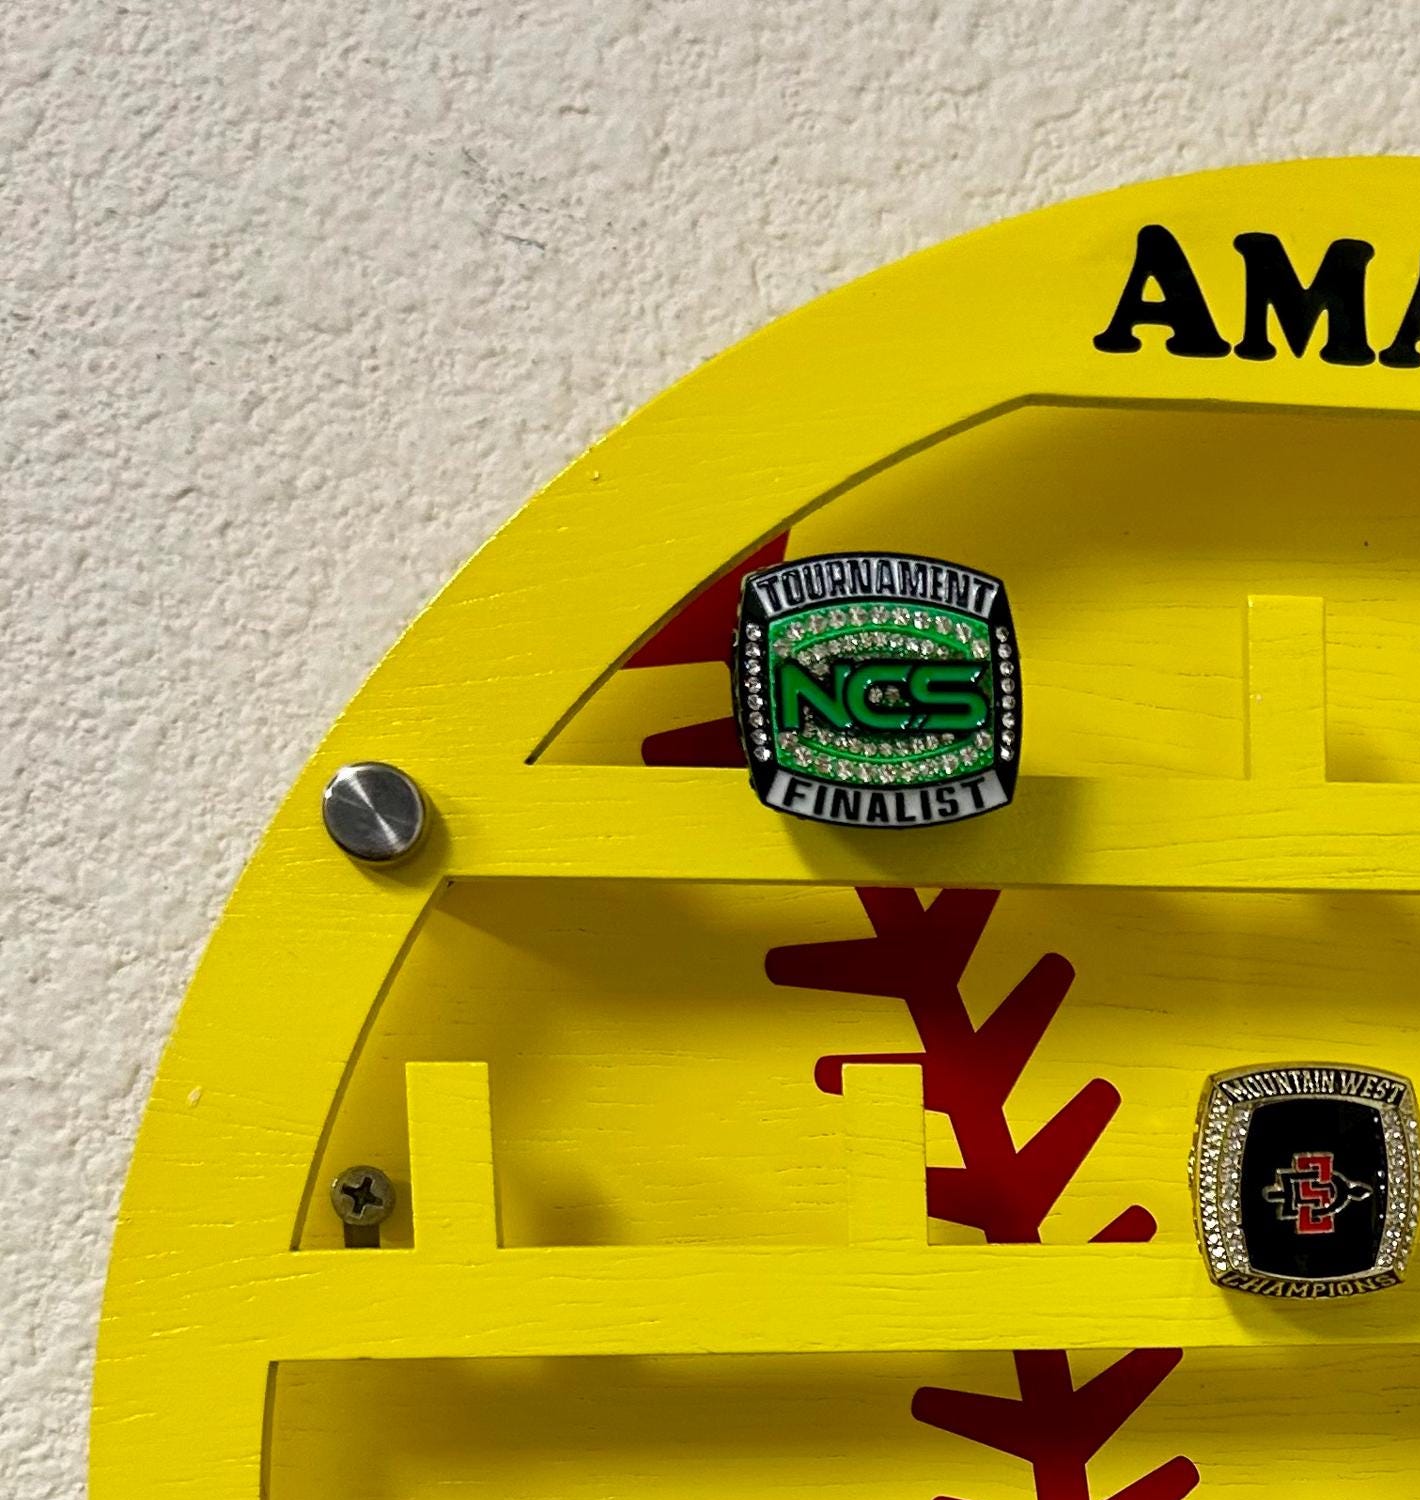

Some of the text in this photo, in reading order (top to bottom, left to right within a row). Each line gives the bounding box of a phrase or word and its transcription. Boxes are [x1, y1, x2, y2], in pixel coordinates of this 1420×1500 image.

[757, 558, 995, 613] TOURNAMENT
[777, 662, 989, 732] NCS
[782, 777, 986, 823] FINALIST
[1221, 1070, 1405, 1104] MOUNTAIN WEST
[1221, 1273, 1398, 1297] CHAMPIONS
